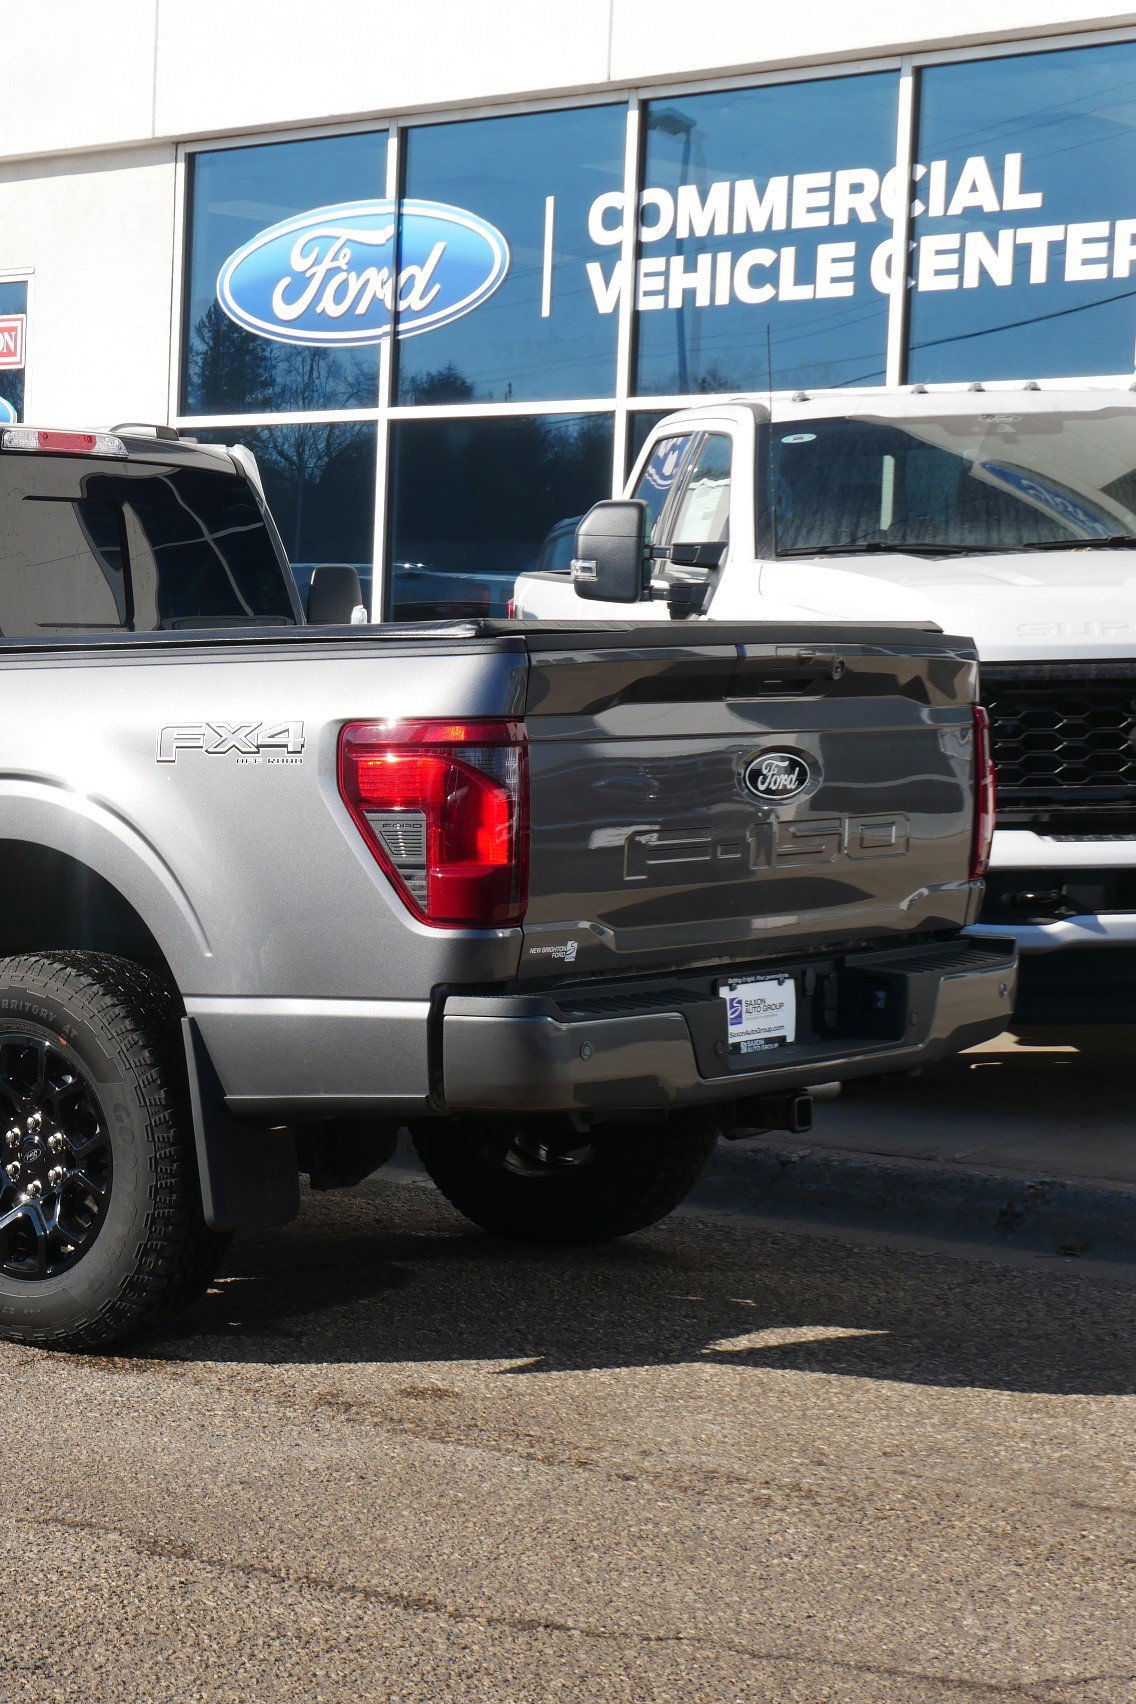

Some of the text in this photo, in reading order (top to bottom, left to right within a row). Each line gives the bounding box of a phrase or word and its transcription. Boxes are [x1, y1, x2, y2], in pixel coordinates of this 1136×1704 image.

[588, 152, 1043, 246] COMMERCIAL
[272, 224, 447, 321] Ford
[586, 241, 856, 313] VEHICLE
[155, 721, 306, 763] FX4
[758, 758, 799, 791] Ford
[624, 811, 910, 880] F-150
[744, 998, 766, 1007] SAXON
[745, 1002, 784, 1015] AUTO GROUP
[729, 1025, 785, 1038] SaxonAutoGroup.com
